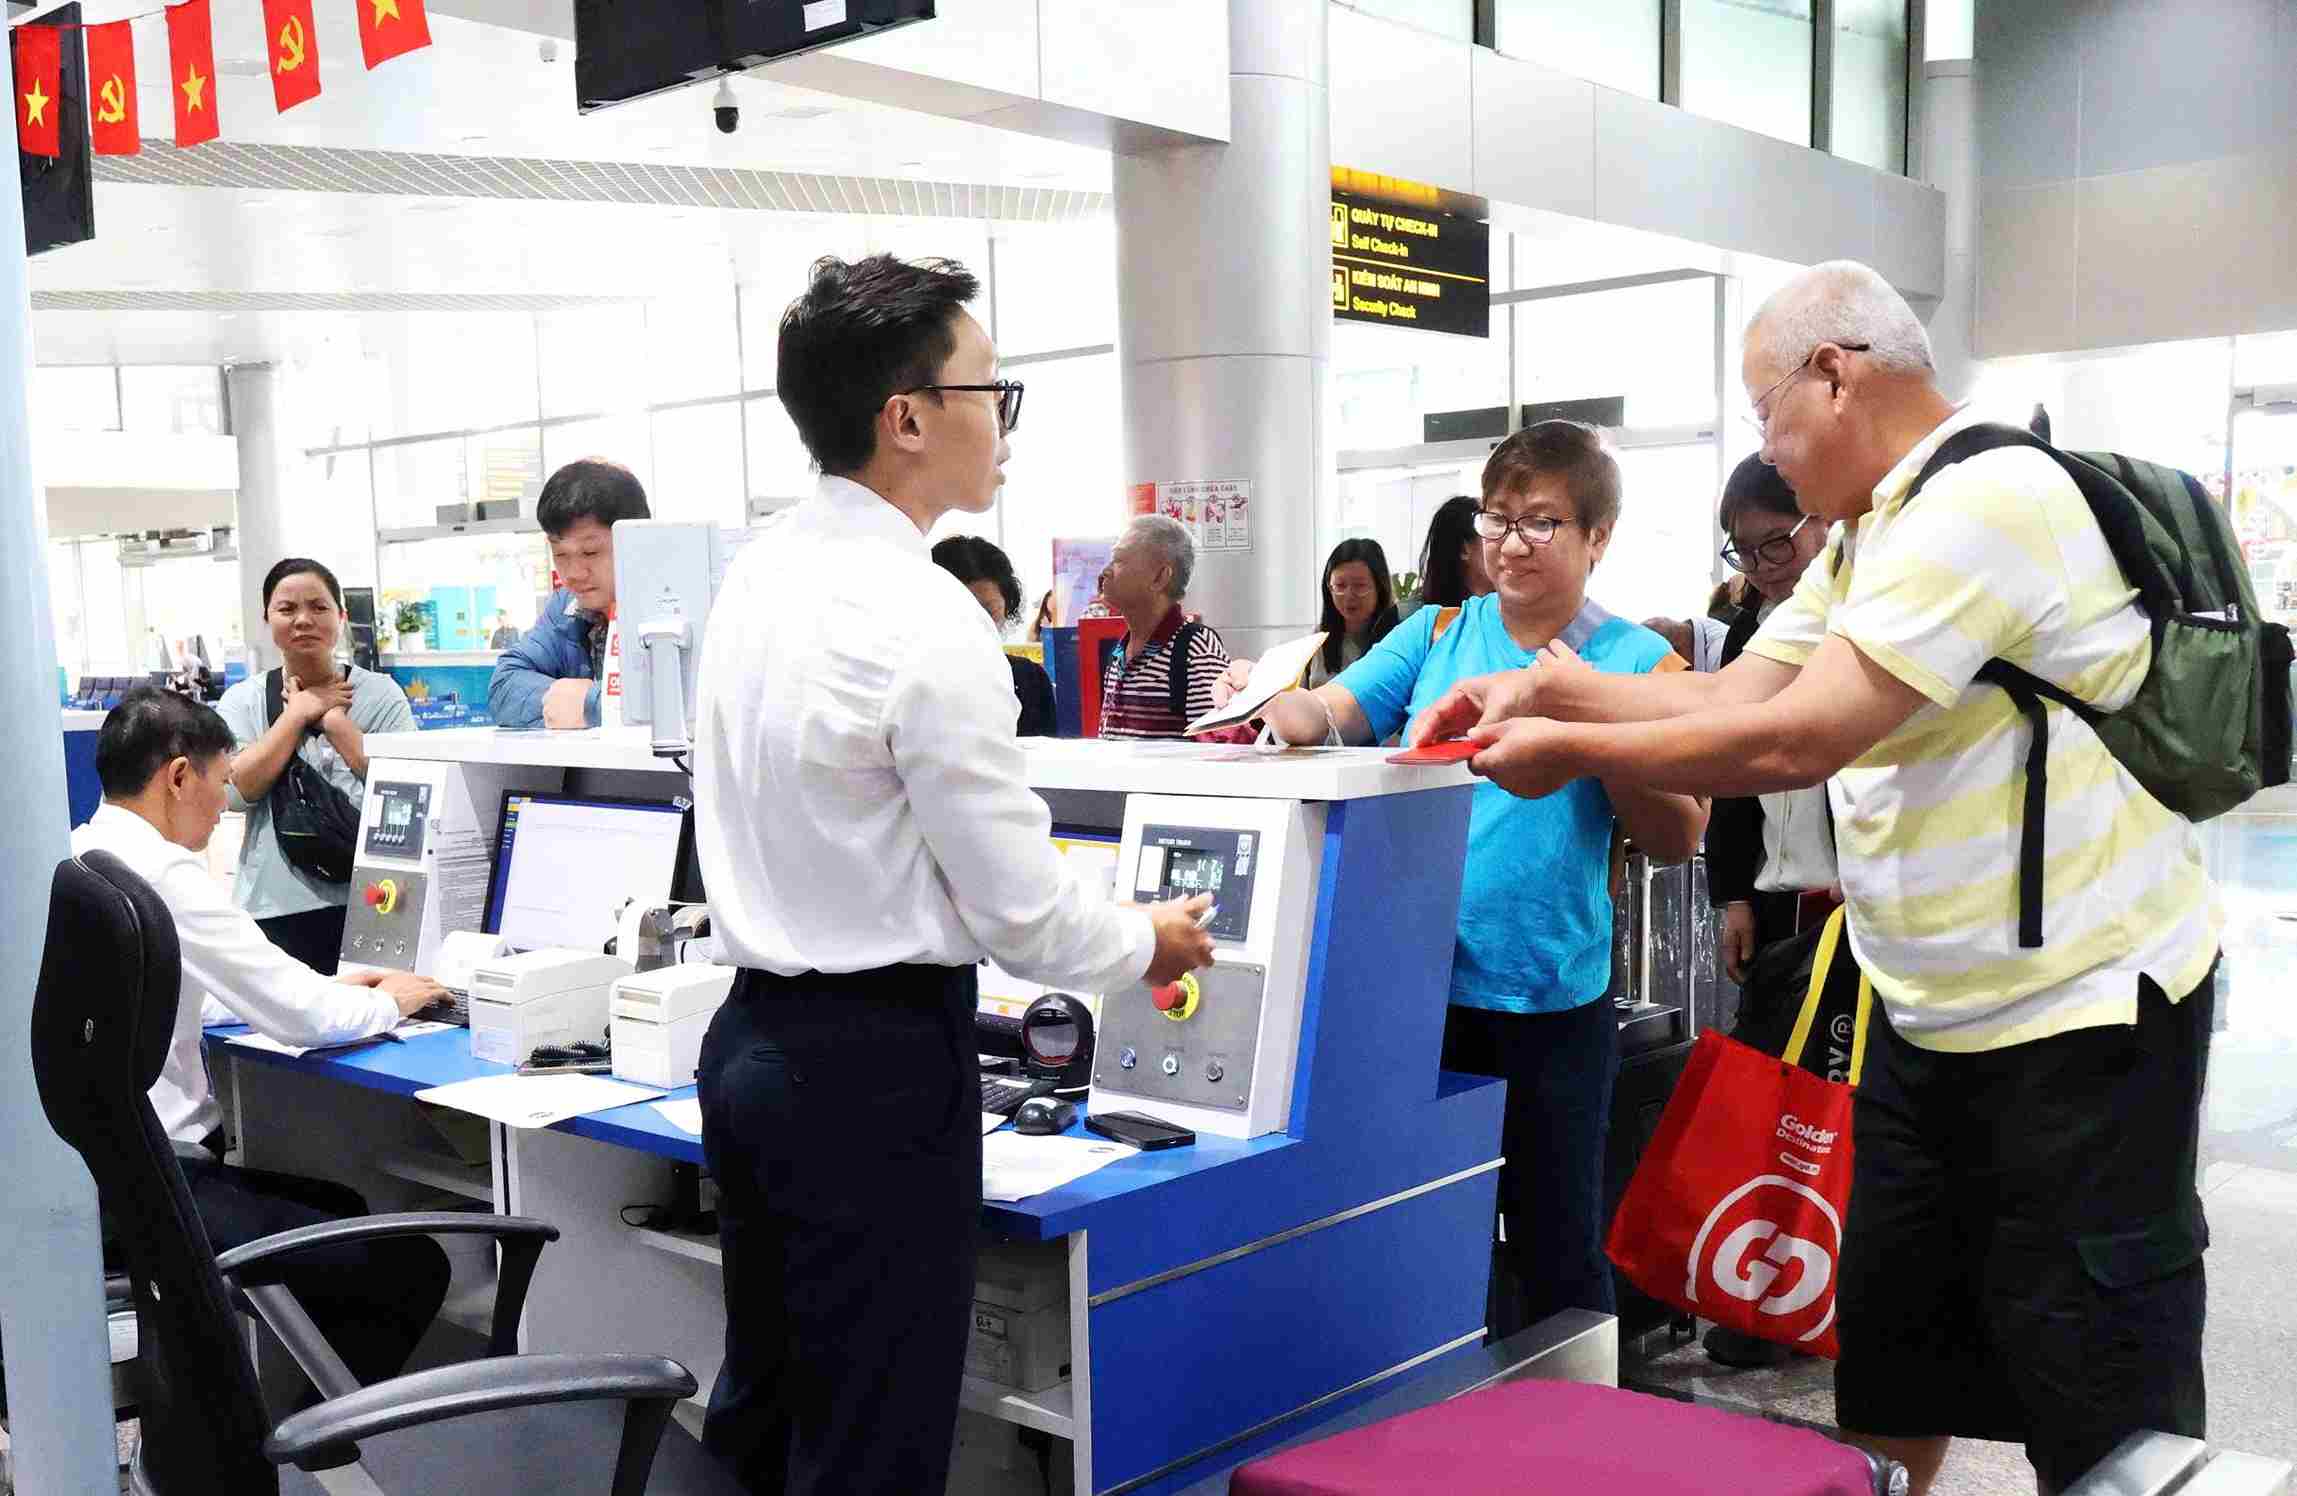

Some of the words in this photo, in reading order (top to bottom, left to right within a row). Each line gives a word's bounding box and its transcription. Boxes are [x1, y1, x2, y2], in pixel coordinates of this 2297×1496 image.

[1395, 217, 1438, 238] CHECK-IN
[1351, 233, 1370, 250] Self
[1403, 279, 1417, 294] AN
[1352, 296, 1388, 317] Security
[1388, 301, 1417, 319] Check
